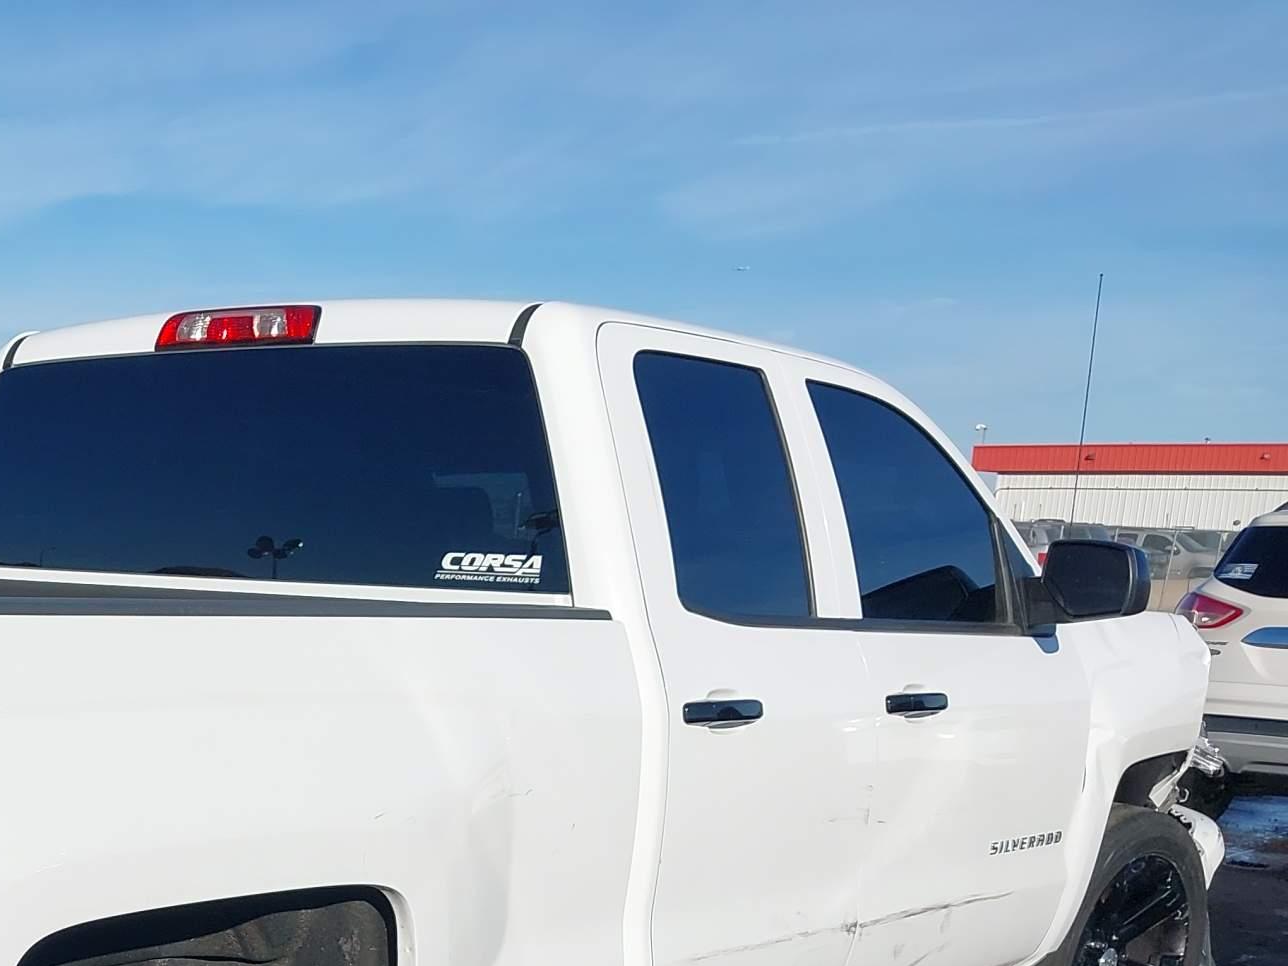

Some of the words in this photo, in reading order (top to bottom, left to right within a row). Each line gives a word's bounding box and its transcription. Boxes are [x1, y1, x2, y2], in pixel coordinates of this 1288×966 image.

[441, 552, 543, 576] CORSA
[434, 574, 495, 583] PERFORMANCE
[496, 577, 541, 585] EXHAUSTS
[989, 831, 1062, 855] SILVERADO
